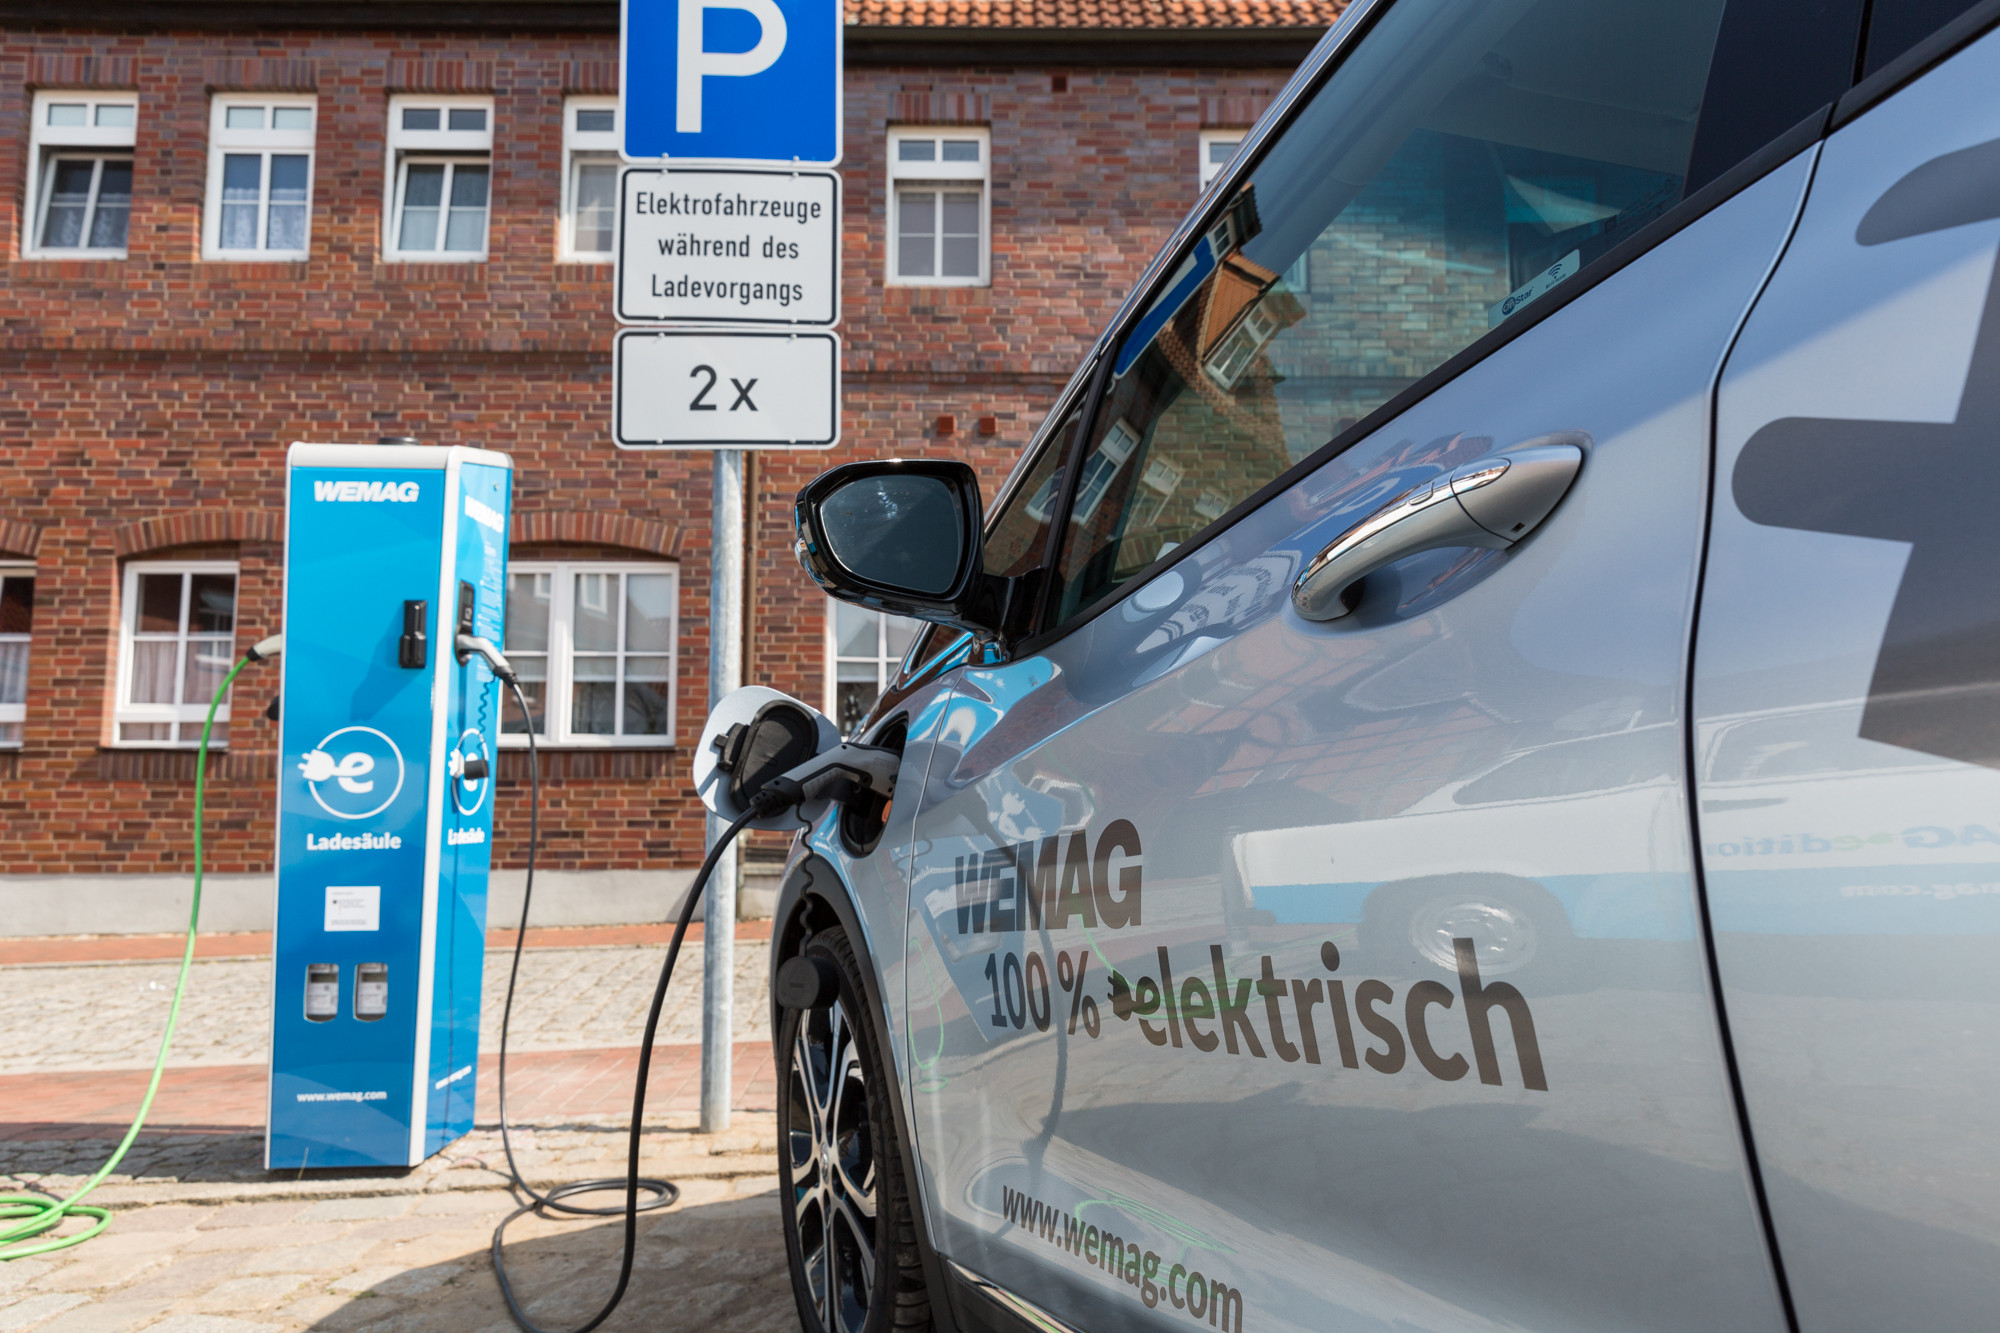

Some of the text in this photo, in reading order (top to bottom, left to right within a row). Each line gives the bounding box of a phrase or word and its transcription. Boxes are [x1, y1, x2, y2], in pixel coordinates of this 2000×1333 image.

[676, 0, 788, 133] P
[636, 192, 822, 224] Elektrofahrzeuge
[658, 234, 800, 259] während des
[651, 274, 804, 306] Ladevorgangs
[314, 481, 420, 502] WEMAG
[306, 832, 402, 850] Ladesäule
[955, 818, 1143, 935] WEMAG
[984, 937, 1549, 1092] 100 % elektrisch
[296, 1090, 388, 1103] www.wemag.com
[1003, 1184, 1243, 1333] www.wemag.com
